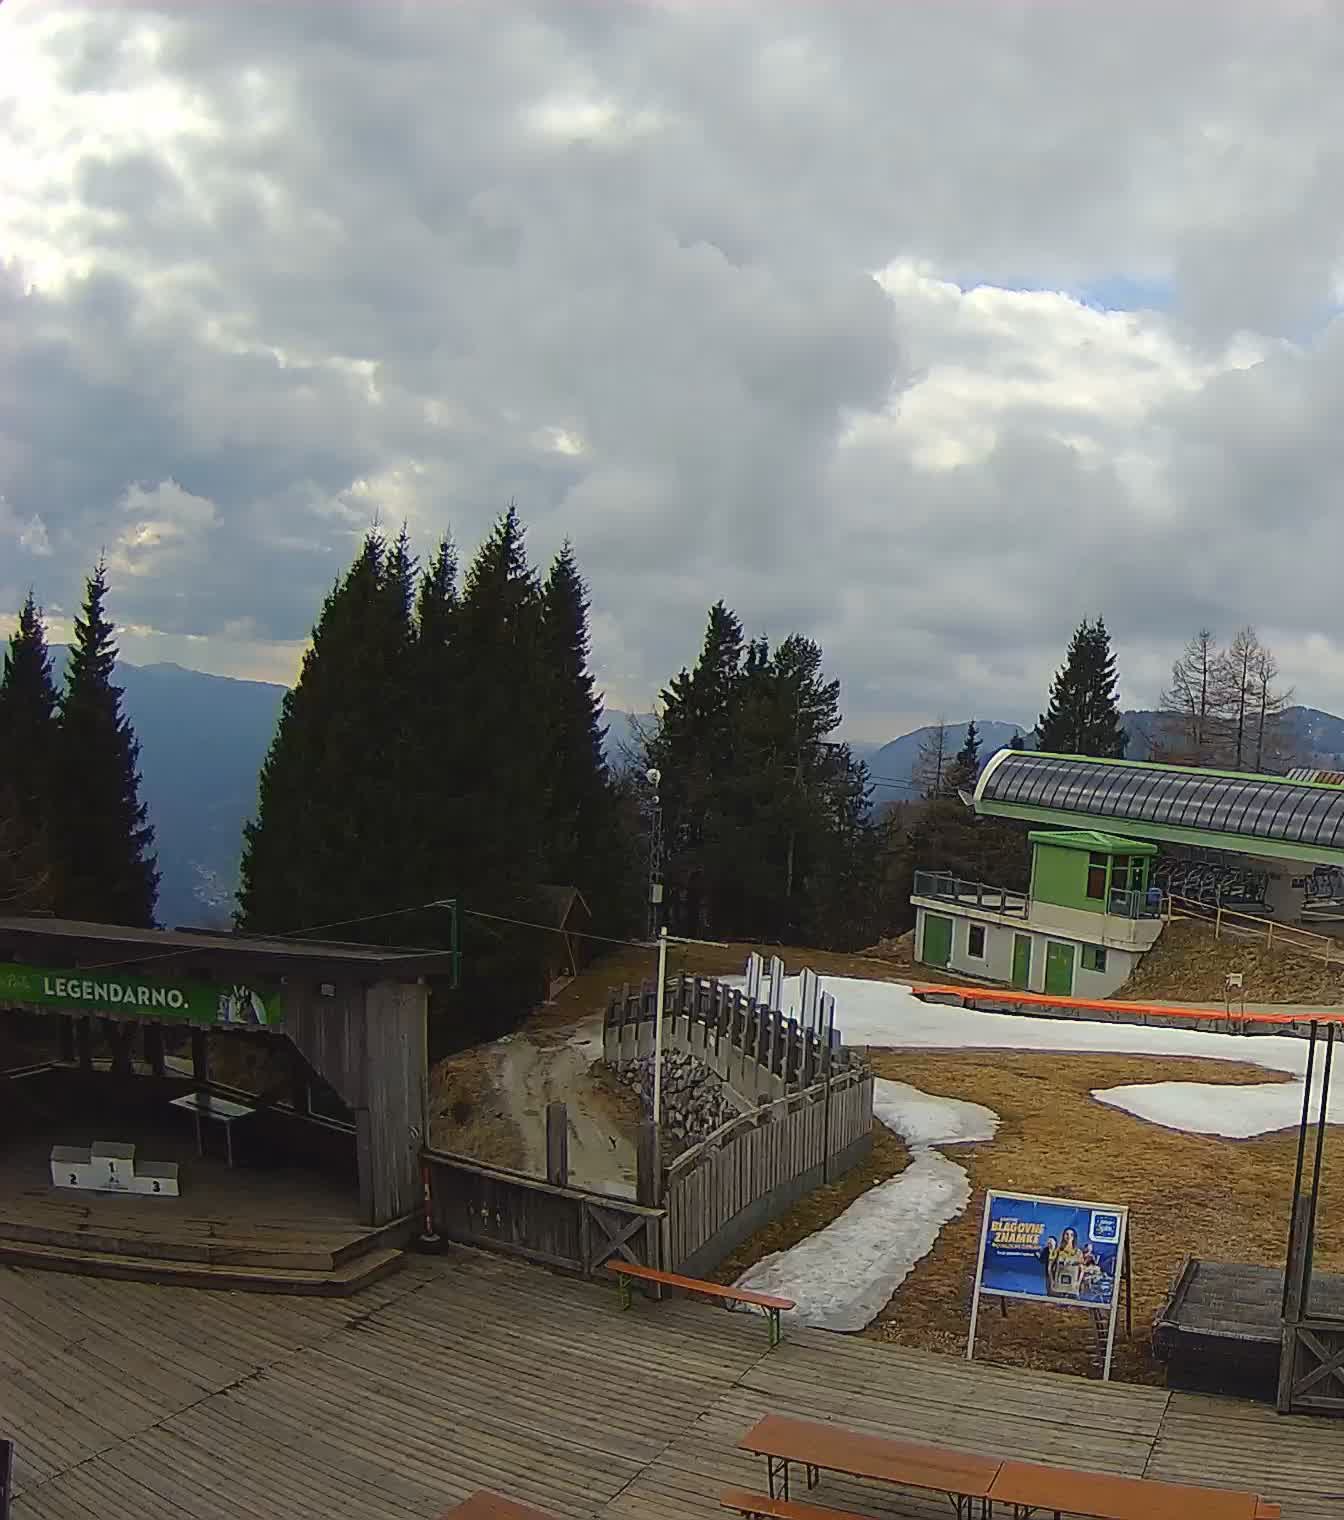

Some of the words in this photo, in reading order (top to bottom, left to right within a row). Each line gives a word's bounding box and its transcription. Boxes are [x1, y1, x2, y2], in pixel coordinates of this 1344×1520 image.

[44, 976, 189, 1009] LEGENDARNO.
[108, 1161, 116, 1173] 1
[68, 1173, 78, 1185] 2
[152, 1180, 161, 1193] 3
